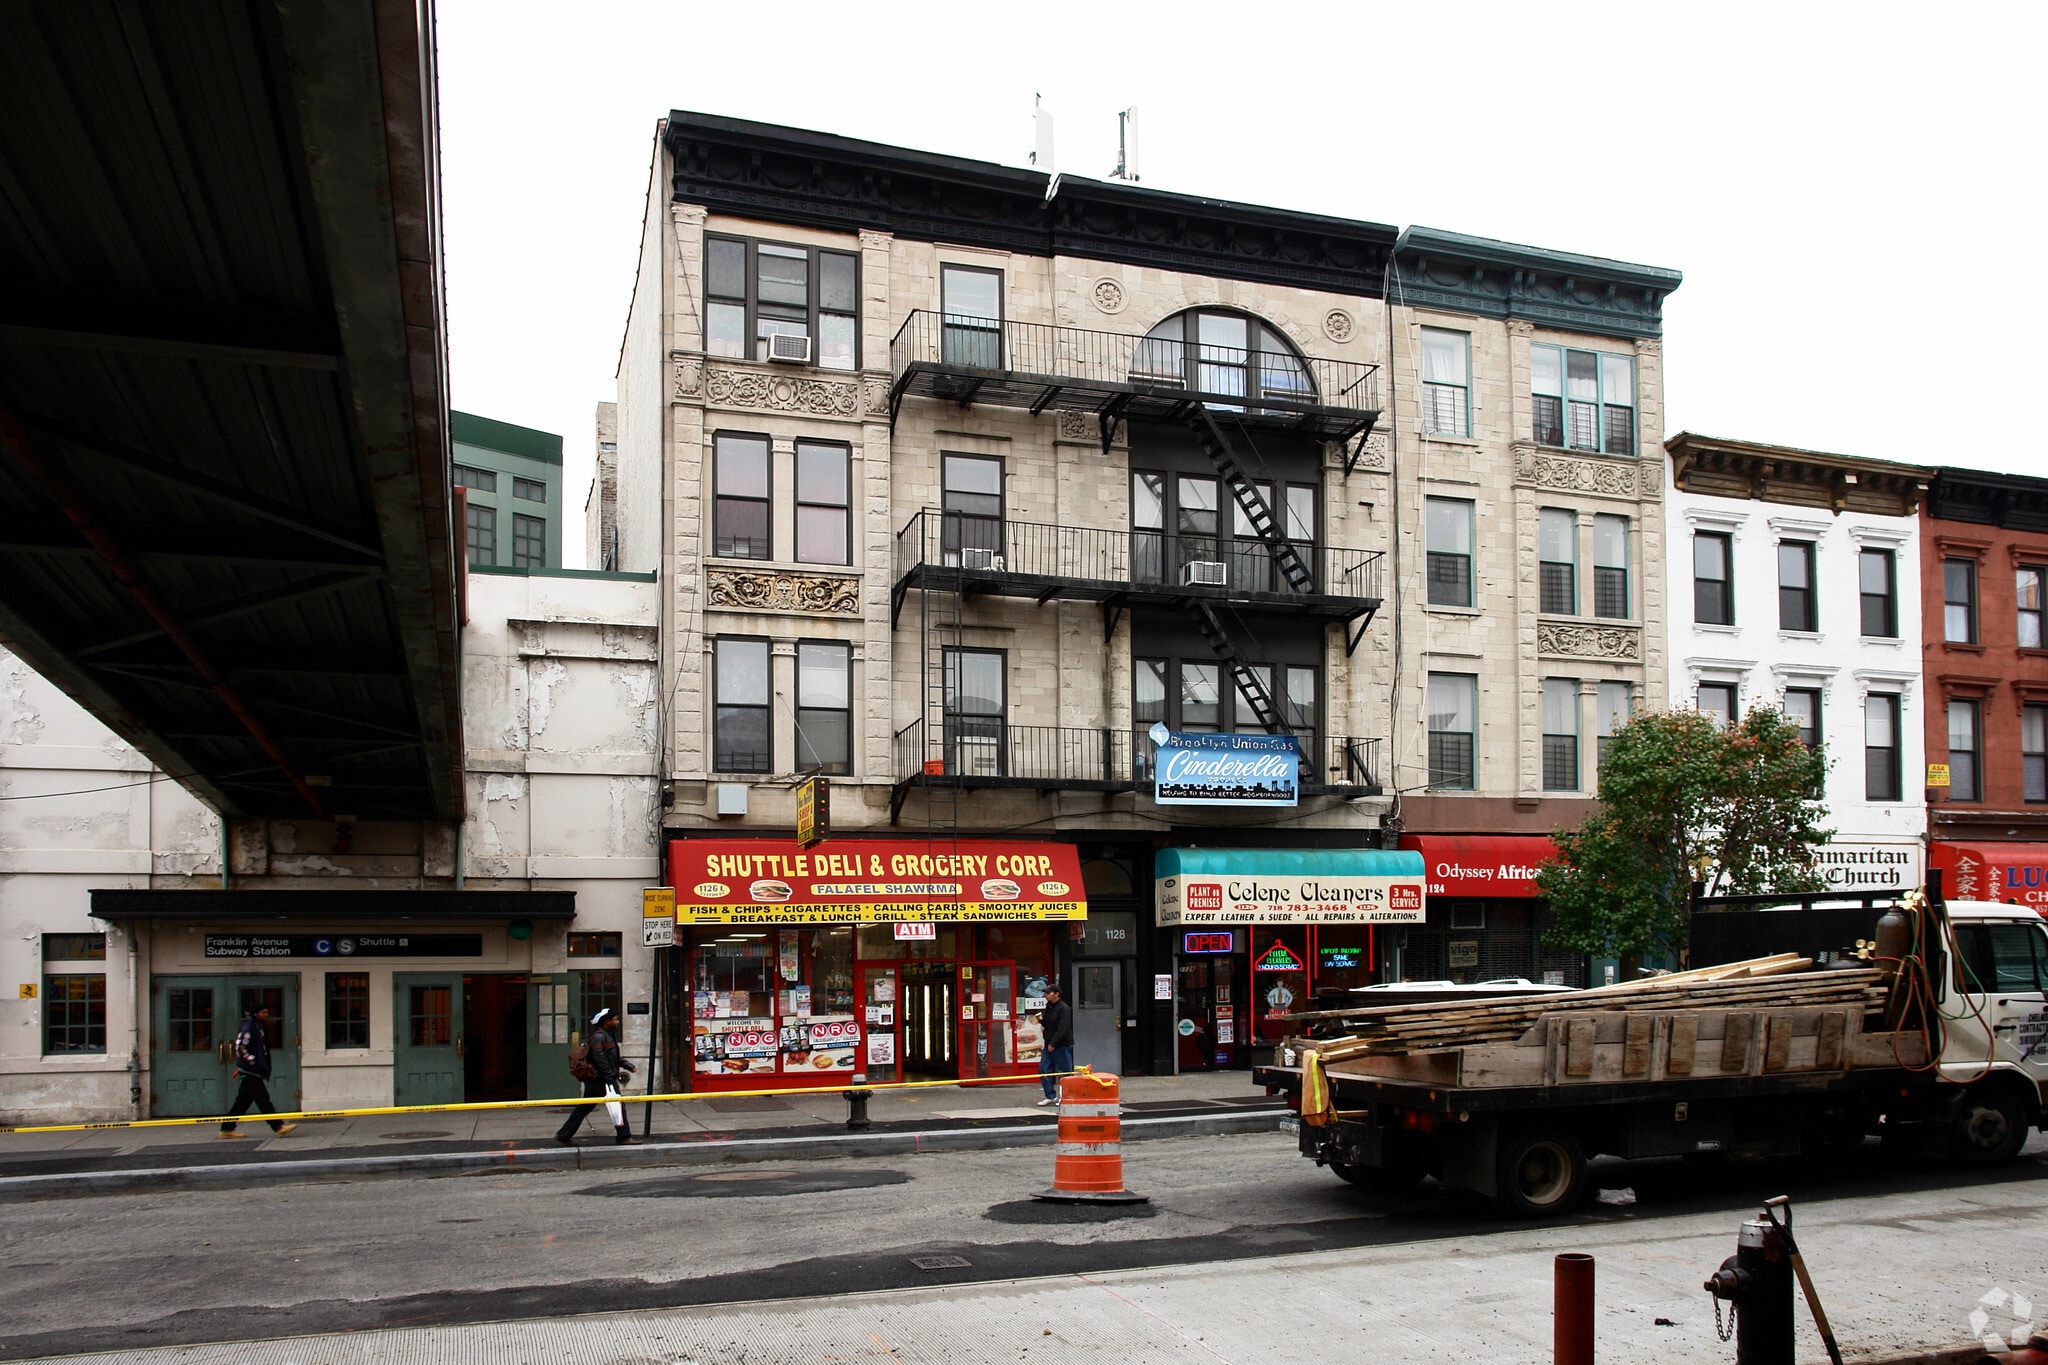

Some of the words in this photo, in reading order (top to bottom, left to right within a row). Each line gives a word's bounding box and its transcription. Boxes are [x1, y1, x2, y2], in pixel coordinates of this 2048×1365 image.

[1170, 736, 1227, 750] Brooklyn
[1232, 737, 1267, 749] Union
[1271, 740, 1294, 751] Gas
[1166, 750, 1289, 781] Cinderella
[706, 854, 809, 877] SHUTTLE
[814, 854, 862, 876] DELI
[870, 854, 885, 876] &
[891, 854, 988, 877] GROCERY
[996, 855, 1053, 876] CORP.
[1436, 863, 1494, 880] Odyssey
[1825, 867, 1901, 887] Church
[2006, 866, 2048, 888] LU
[817, 884, 880, 894] FALAFEL
[885, 884, 957, 894] SHAWRMA
[1190, 887, 1210, 897] PLANT
[1228, 882, 1290, 904] Celene
[1300, 882, 1384, 905] Cleaners
[1393, 888, 1399, 896] 3
[1403, 888, 1417, 897] Hrs.
[689, 906, 717, 914] FISH
[721, 906, 730, 914] &
[735, 906, 771, 914] CHIPS
[783, 905, 861, 913] CIGARETTES
[874, 904, 923, 912] CALLING
[978, 903, 1035, 911] SMOOTHY
[1190, 898, 1220, 908] PREMISES
[1391, 898, 1419, 908] SERVICE
[731, 914, 804, 922] BREAKFAST
[809, 914, 817, 922] &
[874, 913, 907, 921] GRILL
[963, 912, 1037, 920] SANDWICHES
[1185, 913, 1216, 921] EXPERT
[1221, 913, 1254, 921] LEATHER
[645, 921, 658, 929] STOP
[660, 920, 672, 929] HERE
[900, 923, 931, 935] ATM
[654, 932, 661, 940] ON
[663, 931, 672, 939] RED
[1105, 929, 1126, 940] 1128
[206, 937, 247, 947] Franklin
[251, 937, 289, 947] Avenue
[316, 940, 329, 953] C
[340, 940, 352, 953] S
[360, 937, 395, 946] Shuttle
[1187, 935, 1231, 951] OPEN
[206, 946, 248, 957] Subway
[252, 947, 291, 956] Station
[814, 1023, 857, 1036] NRG
[730, 1033, 775, 1046] NRG
